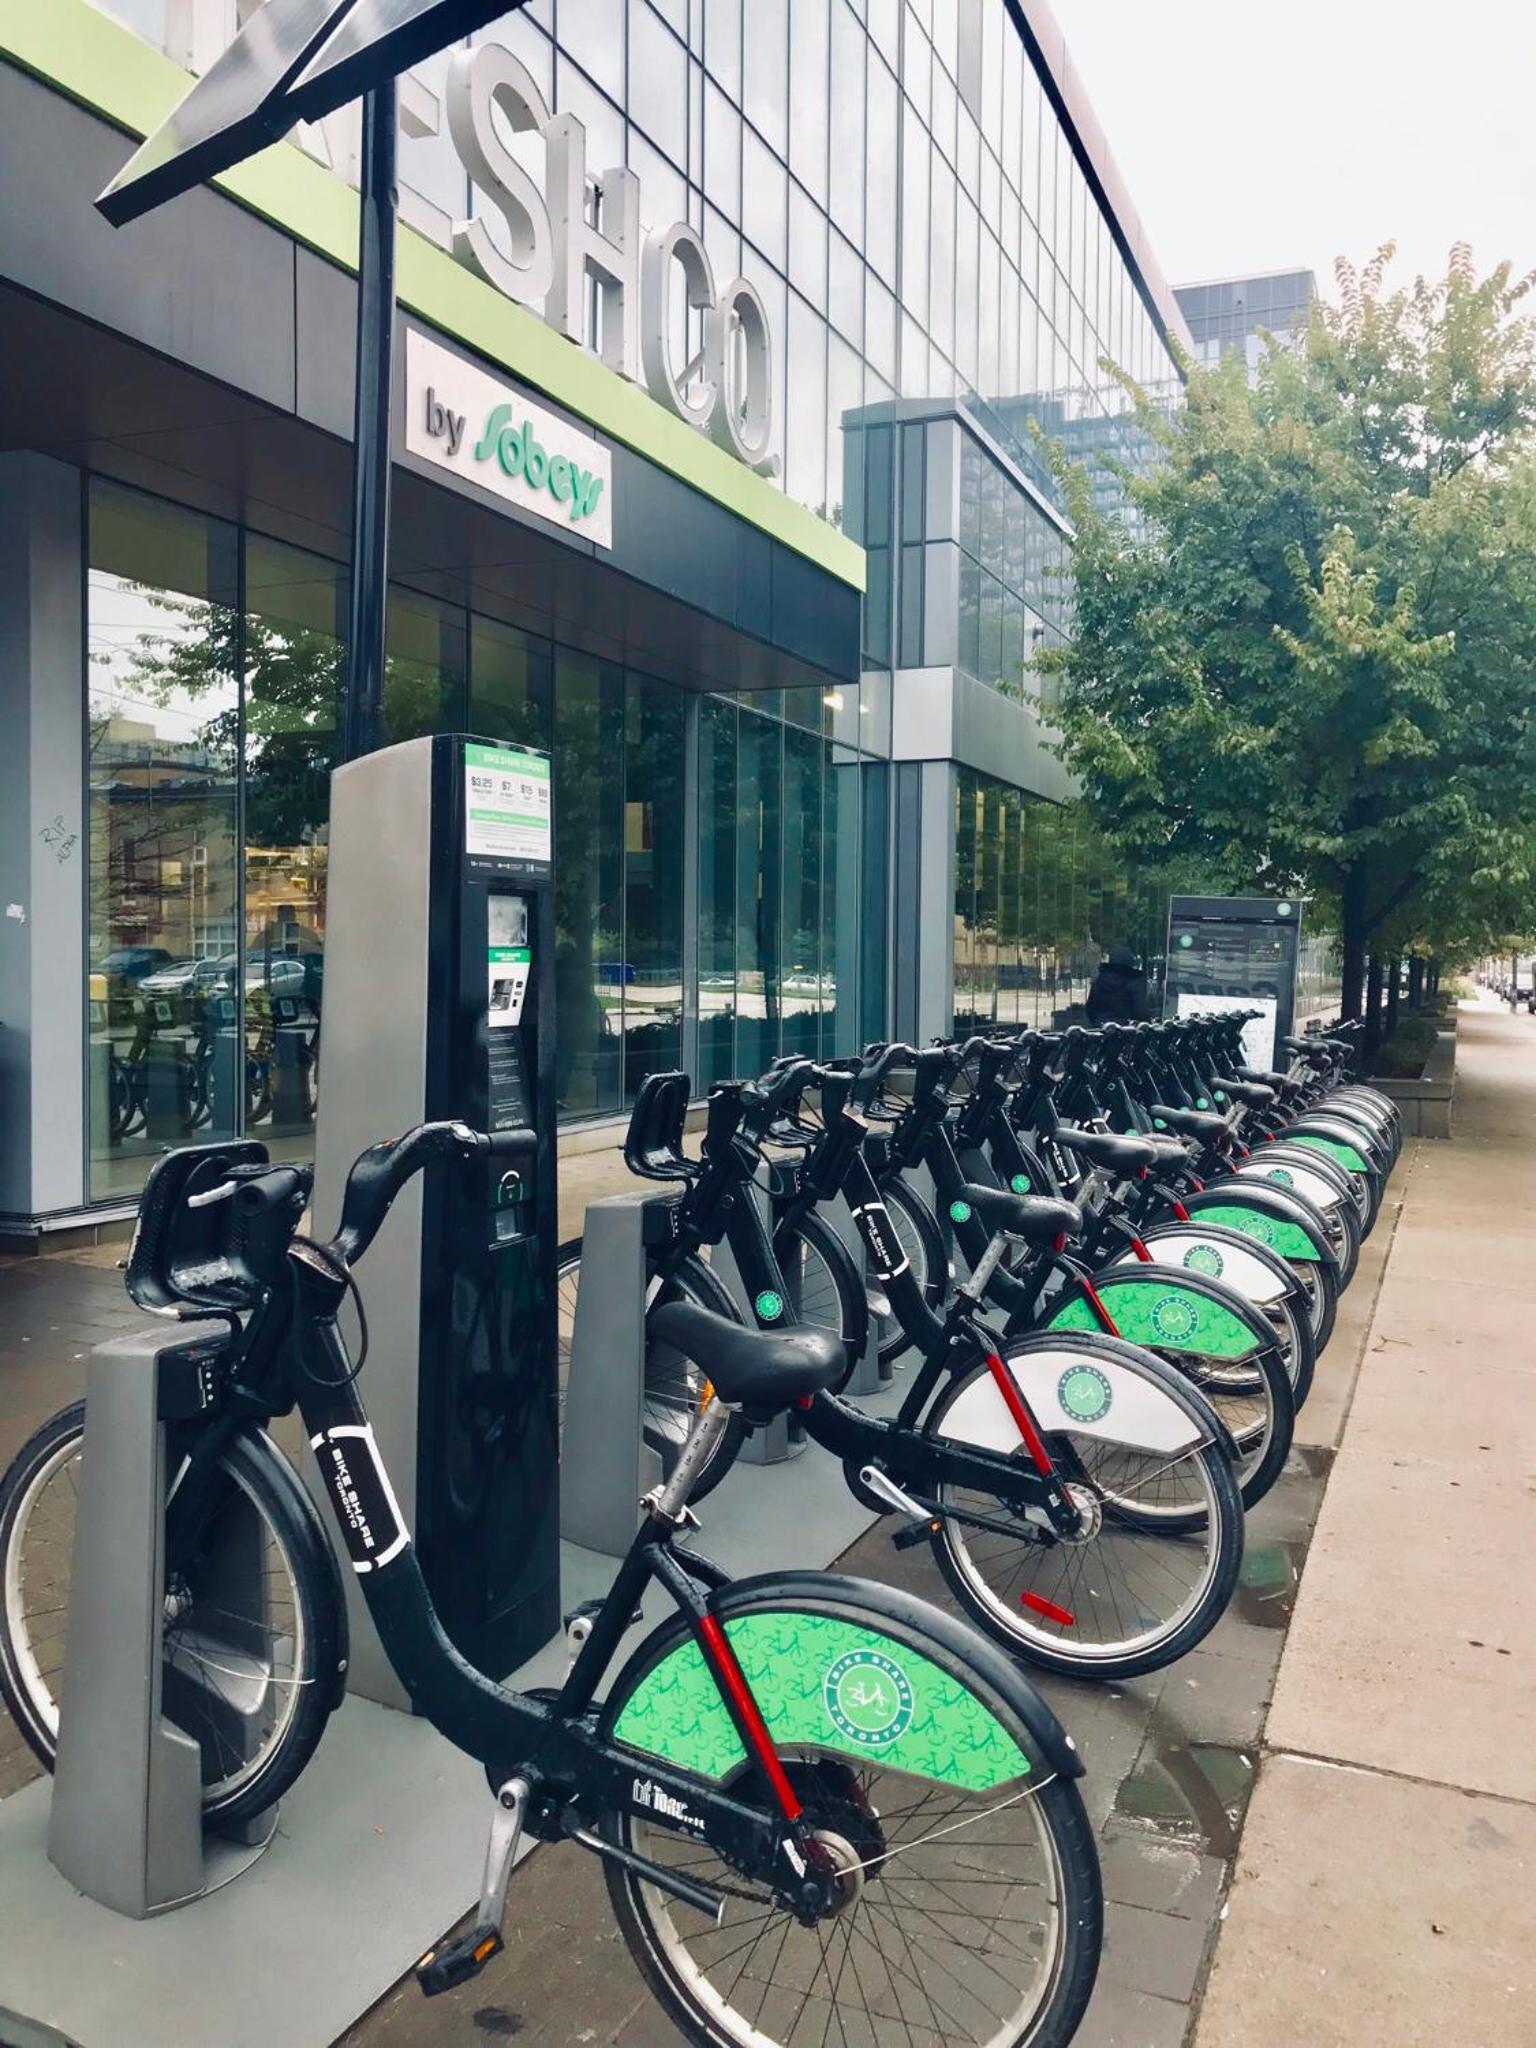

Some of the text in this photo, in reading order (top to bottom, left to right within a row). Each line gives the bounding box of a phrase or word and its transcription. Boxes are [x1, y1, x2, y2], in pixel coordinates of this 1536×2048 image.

[426, 386, 604, 522] by Sobeys
[332, 1448, 375, 1549] BIKE SHARE
[334, 1474, 358, 1529] TORONTO
[832, 1654, 909, 1700] BIKE SHARE
[831, 1705, 901, 1740] TORONTO
